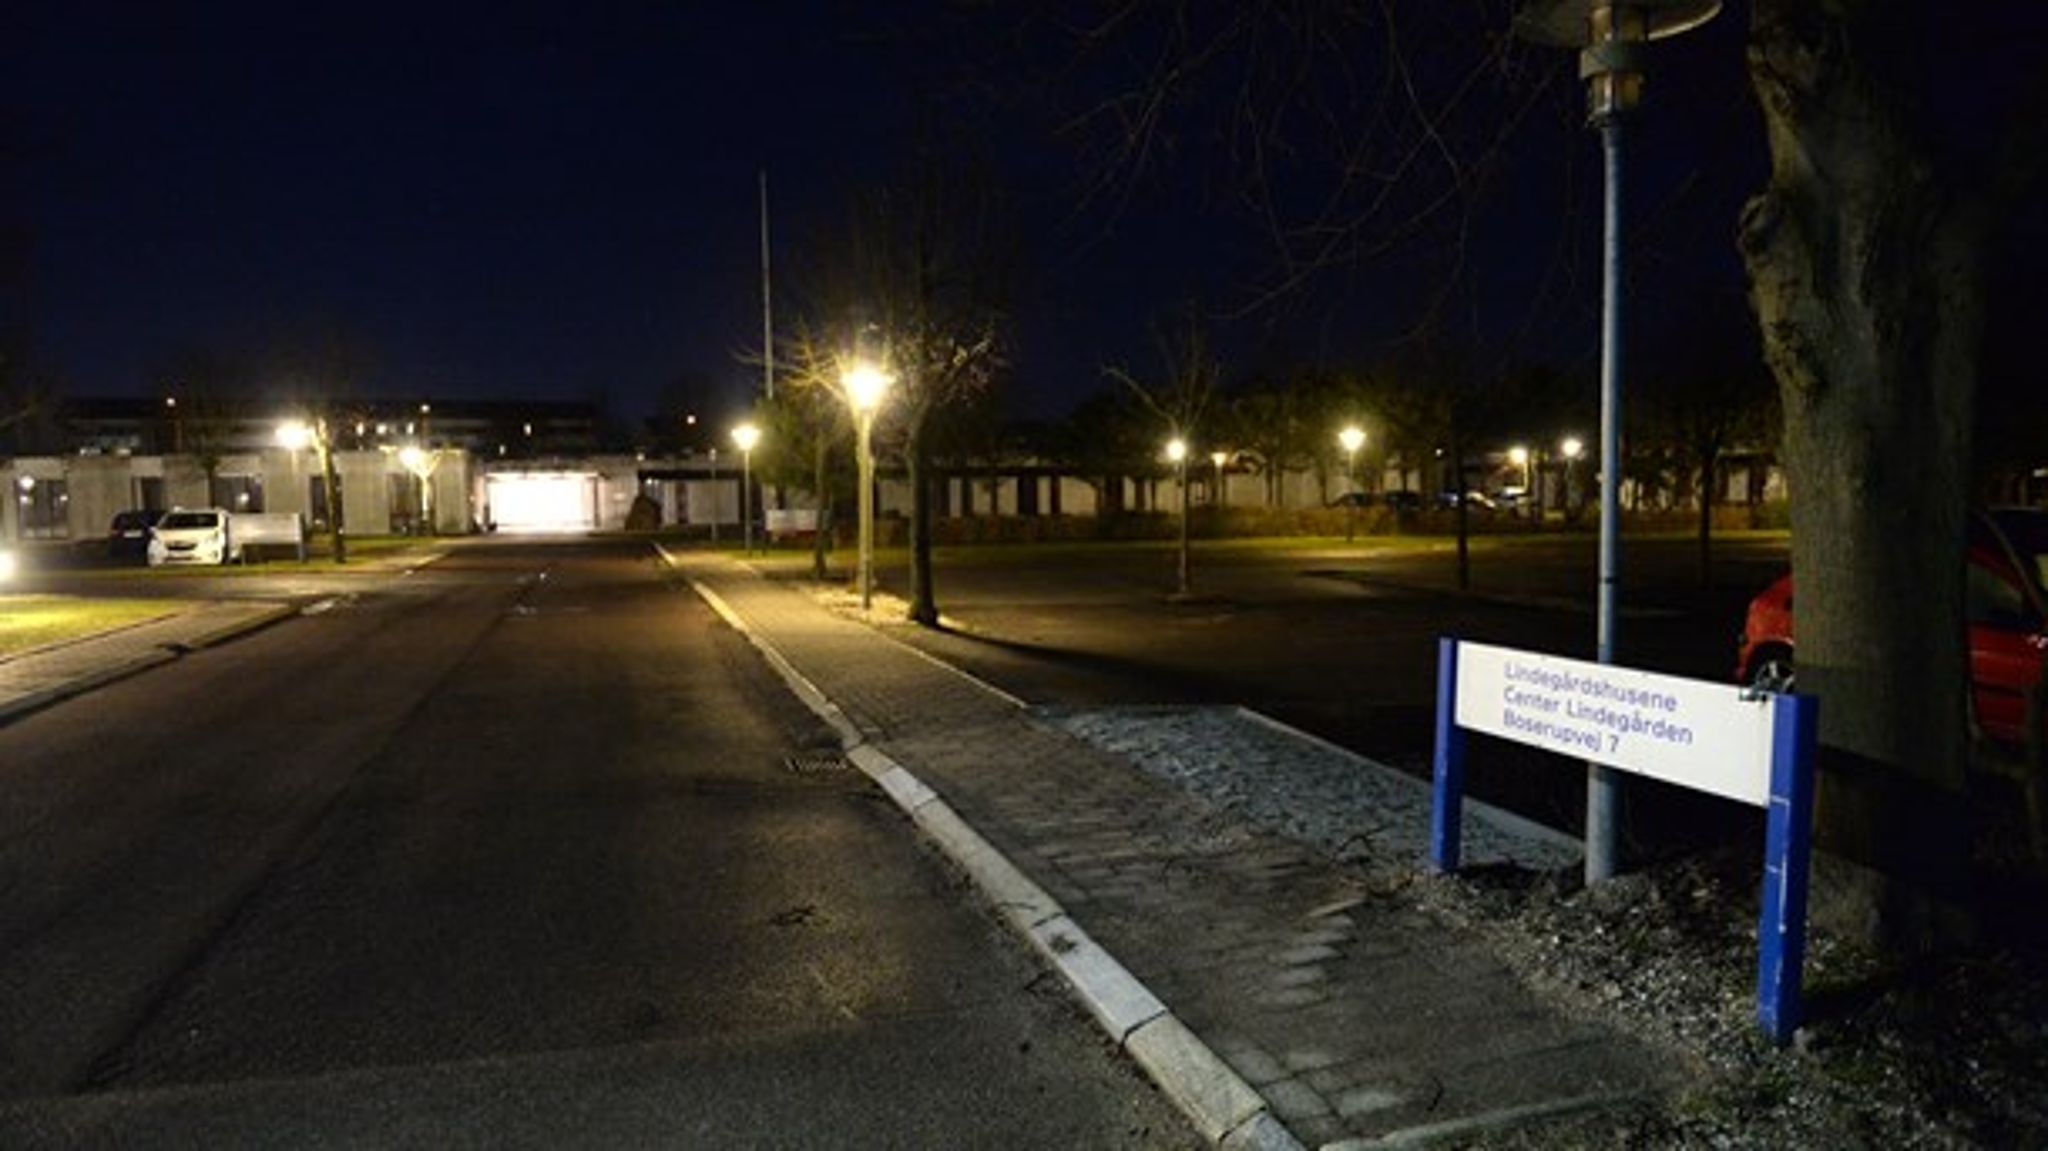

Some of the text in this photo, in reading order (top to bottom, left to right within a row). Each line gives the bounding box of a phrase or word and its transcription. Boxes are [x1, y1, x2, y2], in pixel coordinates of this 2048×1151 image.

[1504, 661, 1678, 711] Lindegårdshusene
[1503, 686, 1693, 744] Center Lindegården
[1503, 709, 1620, 752] Boserupvej 7
